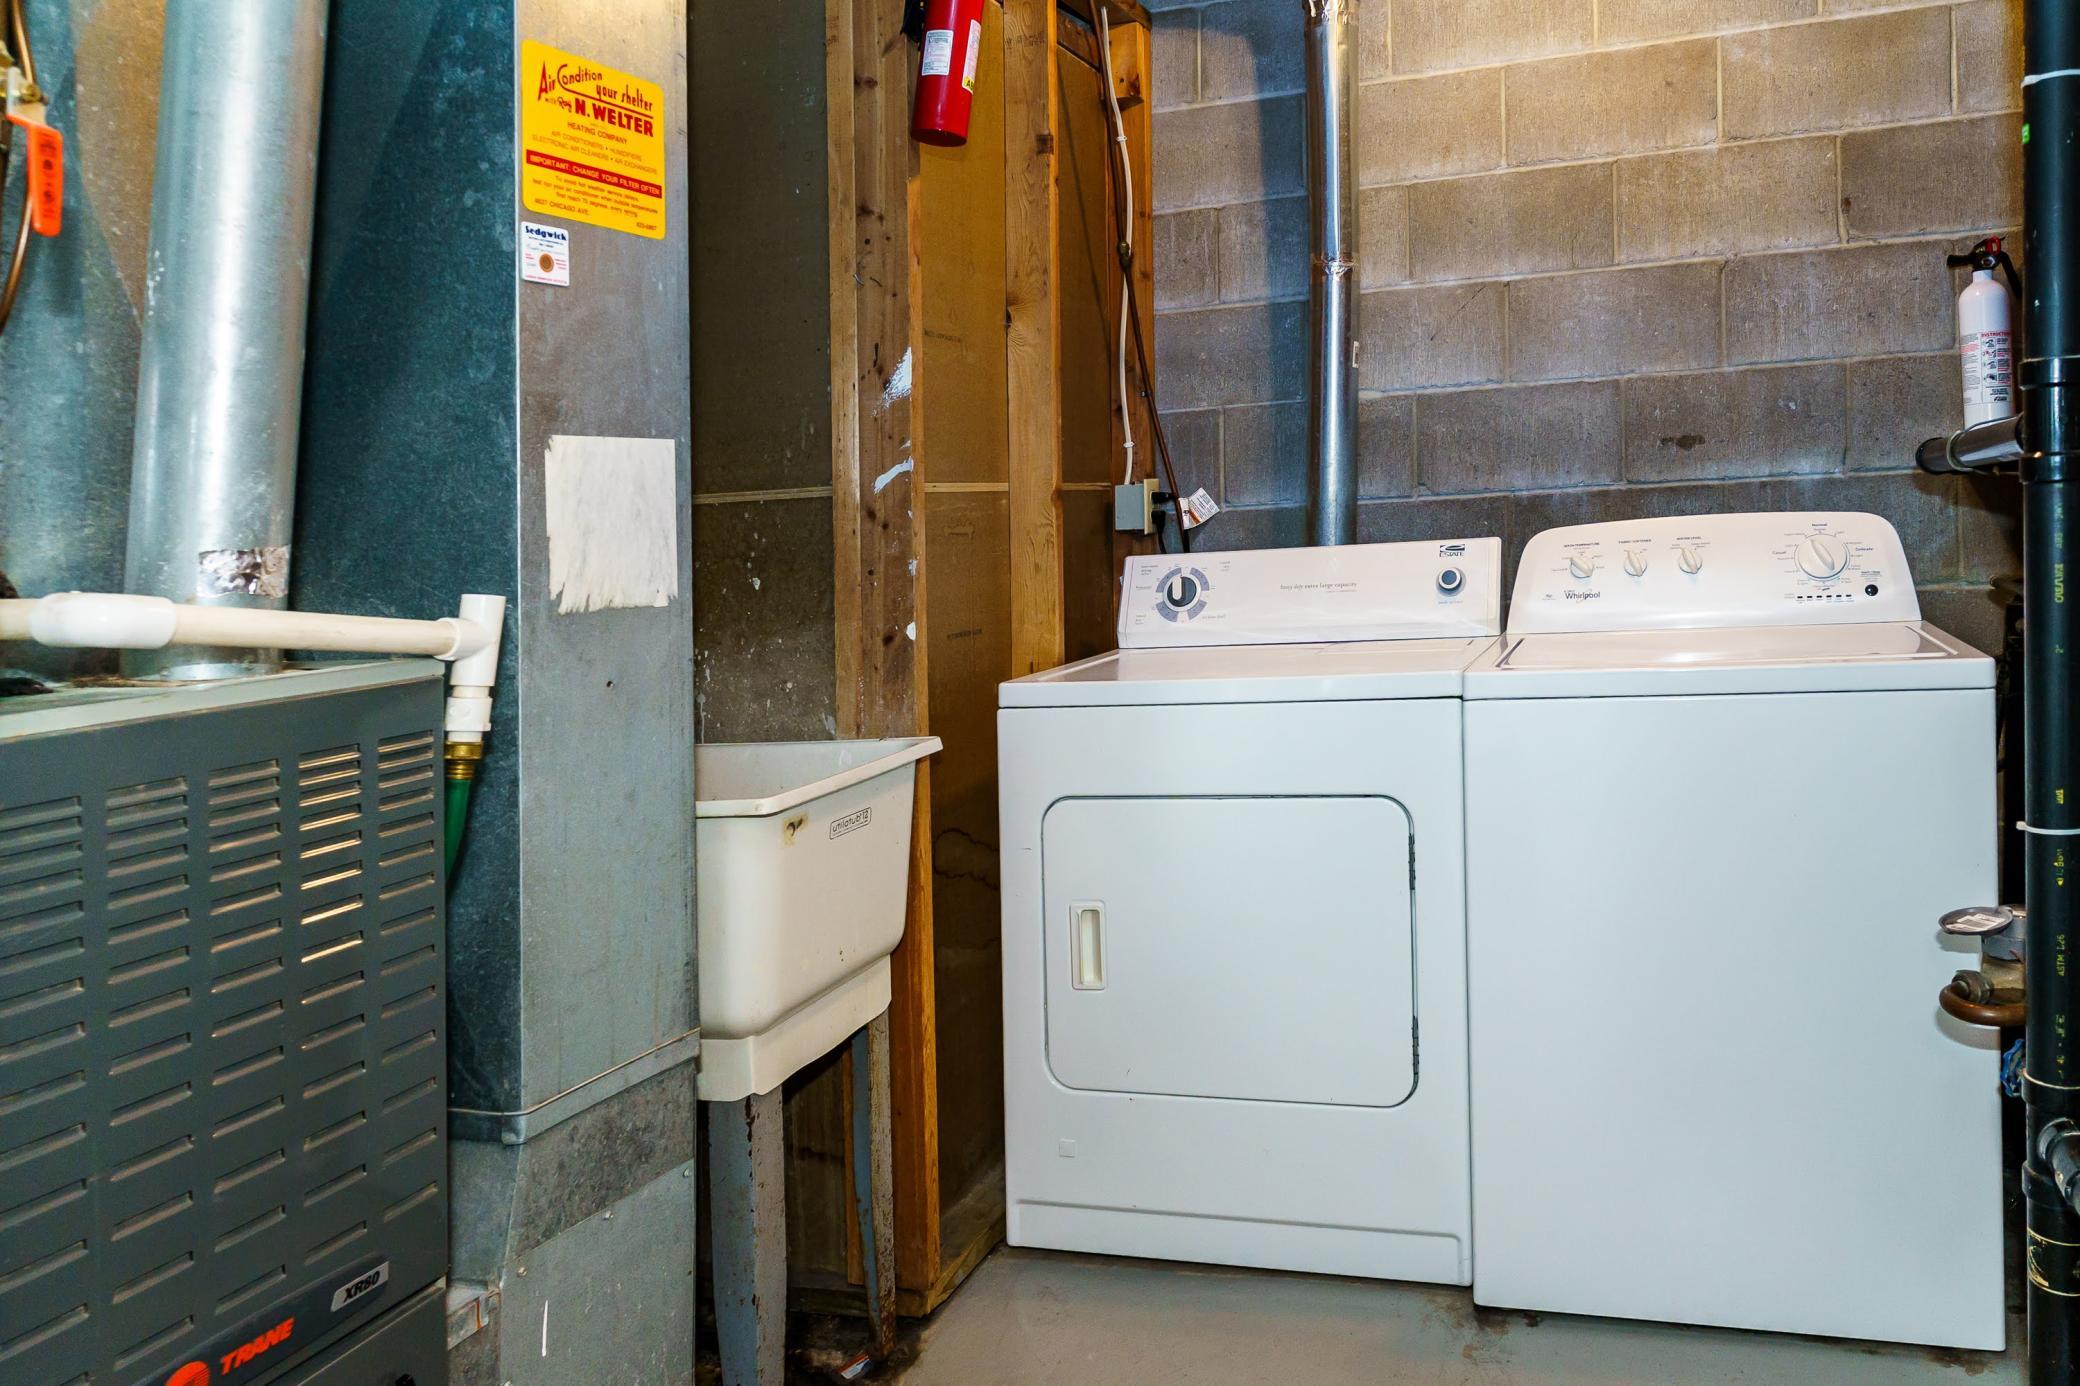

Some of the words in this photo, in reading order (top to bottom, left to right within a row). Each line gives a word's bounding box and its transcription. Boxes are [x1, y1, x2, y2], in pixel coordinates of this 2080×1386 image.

[538, 61, 555, 101] Air
[557, 64, 602, 91] Condition
[595, 84, 618, 102] your
[621, 84, 653, 112] shelter
[567, 122, 596, 136] HEATING
[598, 130, 627, 144] COMPANY
[592, 103, 654, 137] WELTER
[572, 165, 599, 179] CHANGE
[601, 171, 619, 184] YOUR
[619, 174, 640, 190] FILTER
[640, 181, 660, 195] OFTEN
[525, 225, 567, 241] Sedgwick
[1565, 592, 1601, 601] Whirlpool
[342, 1270, 381, 1303] XR80
[220, 1317, 295, 1376] TRANE
